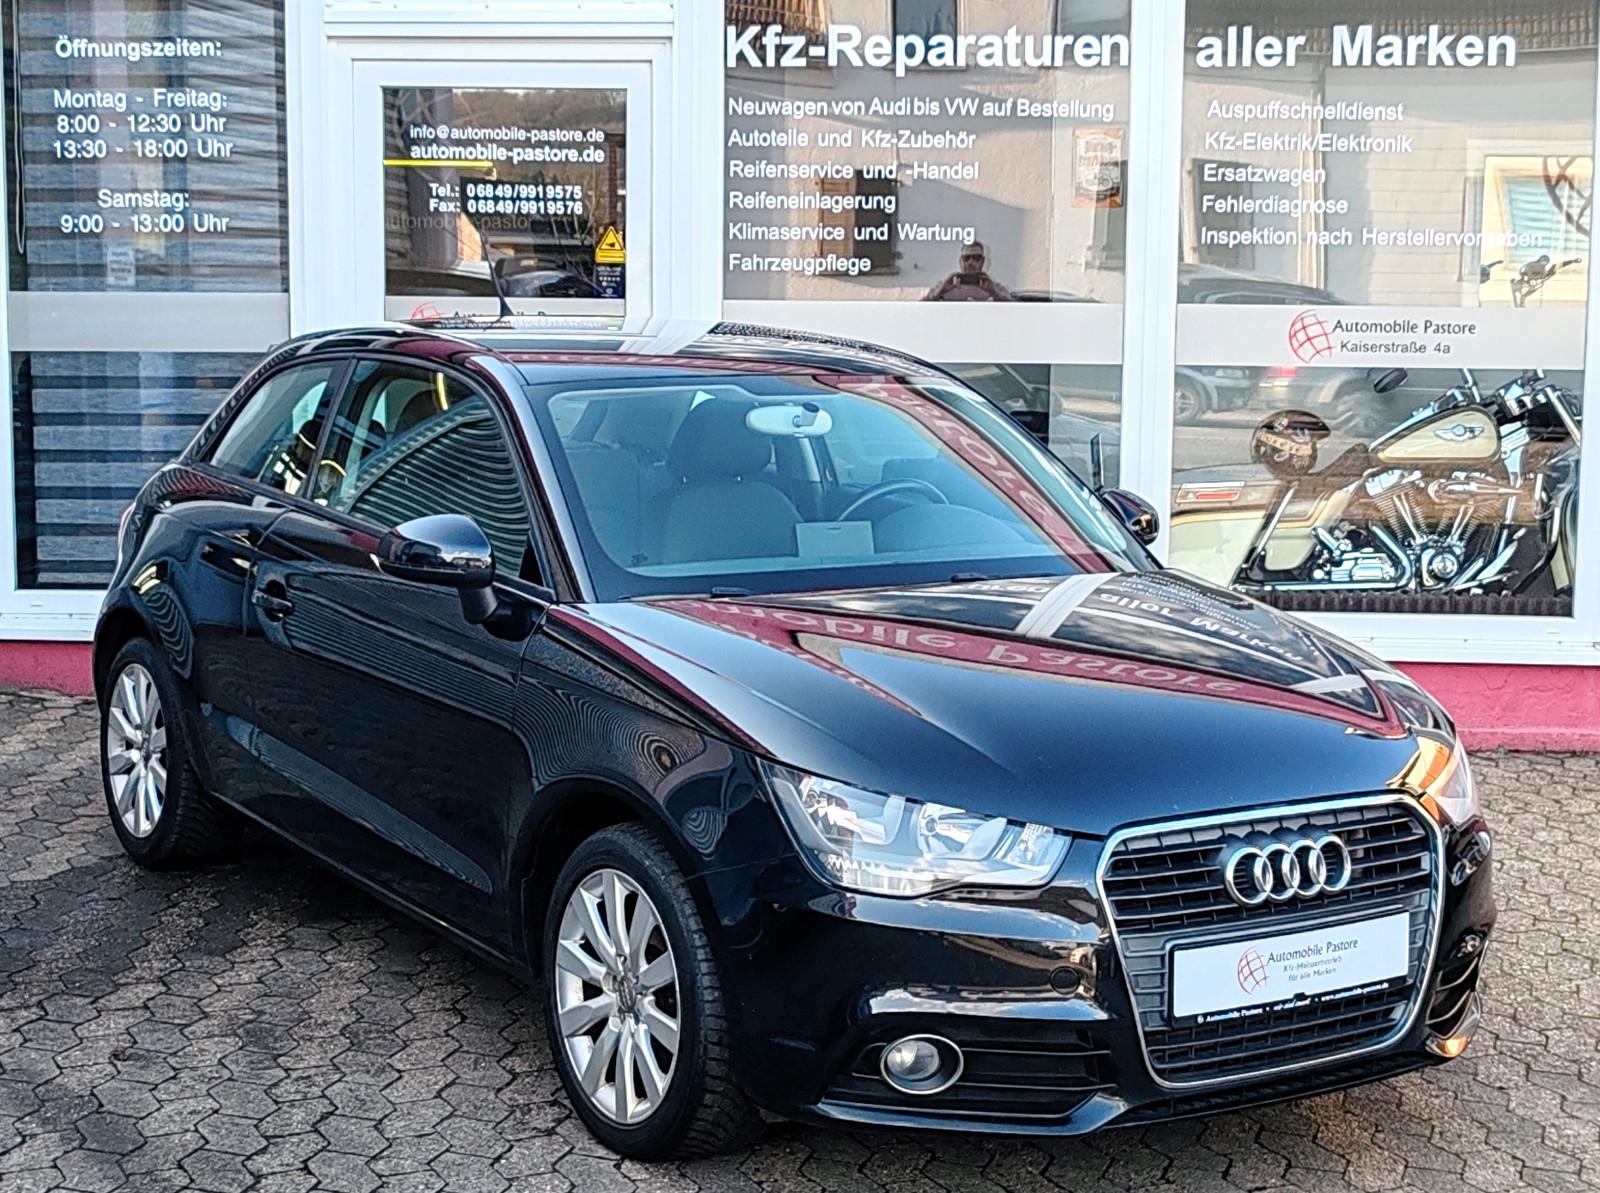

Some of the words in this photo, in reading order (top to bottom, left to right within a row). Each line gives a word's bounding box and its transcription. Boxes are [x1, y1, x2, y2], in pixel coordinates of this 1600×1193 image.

[55, 35, 222, 61] Öffnungszeiten:
[726, 24, 1130, 77] Kfz-Reparaturen
[1196, 25, 1305, 67] aller
[1332, 24, 1516, 67] Marken
[53, 90, 127, 111] Montag
[153, 88, 228, 111] Freitag:
[728, 97, 827, 119] Neuwagen
[832, 101, 865, 116] von
[869, 97, 911, 117] Audi
[913, 97, 940, 117] bis
[945, 98, 978, 117] VW
[982, 98, 1013, 117] auf
[1017, 98, 1114, 122] Bestellung
[57, 115, 99, 133] 8:00
[128, 114, 181, 133] 12:30
[190, 114, 227, 133] Uhr
[1207, 101, 1404, 124] Auspuffschnelldienst
[409, 124, 605, 144] info@automobile-pastore.de
[728, 129, 809, 148] Autoteile
[817, 130, 852, 148] und
[862, 129, 976, 149] Kfz-Zubehör
[1205, 131, 1412, 153] Kfz-Elektrik/Elektronik
[53, 140, 107, 159] 13:30
[134, 139, 188, 158] 18:00
[197, 139, 233, 158] Uhr
[410, 143, 605, 164] automobile-pastore.de
[729, 160, 853, 180] Reifenservice
[863, 161, 897, 179] und
[906, 161, 979, 180] -Handel
[1203, 163, 1326, 186] Ersatzwagen
[98, 189, 190, 211] Samstag:
[429, 182, 460, 198] Tel.:
[467, 183, 583, 199] 06849/9919575
[429, 198, 461, 213] Fax:
[467, 199, 583, 214] 06849/9919576
[729, 191, 896, 213] Reifeneinlagerung
[1202, 195, 1348, 217] Fehlerdiagnose
[60, 215, 103, 233] 9:00
[131, 215, 184, 233] 13:00
[193, 214, 229, 233] Uhr
[729, 222, 845, 241] Klimaservice
[854, 222, 888, 241] und
[897, 223, 976, 244] Wartung
[1201, 226, 1297, 248] Inspektion
[1306, 228, 1352, 246] nach
[729, 253, 871, 275] Fahrzeugpflege
[1332, 318, 1418, 335] Automobile
[1423, 319, 1477, 335] Pastore
[1340, 339, 1427, 354] Kaiserstraße
[1433, 340, 1451, 354] 4a
[1266, 943, 1324, 965] Automobile
[1326, 938, 1358, 956] Pastore
